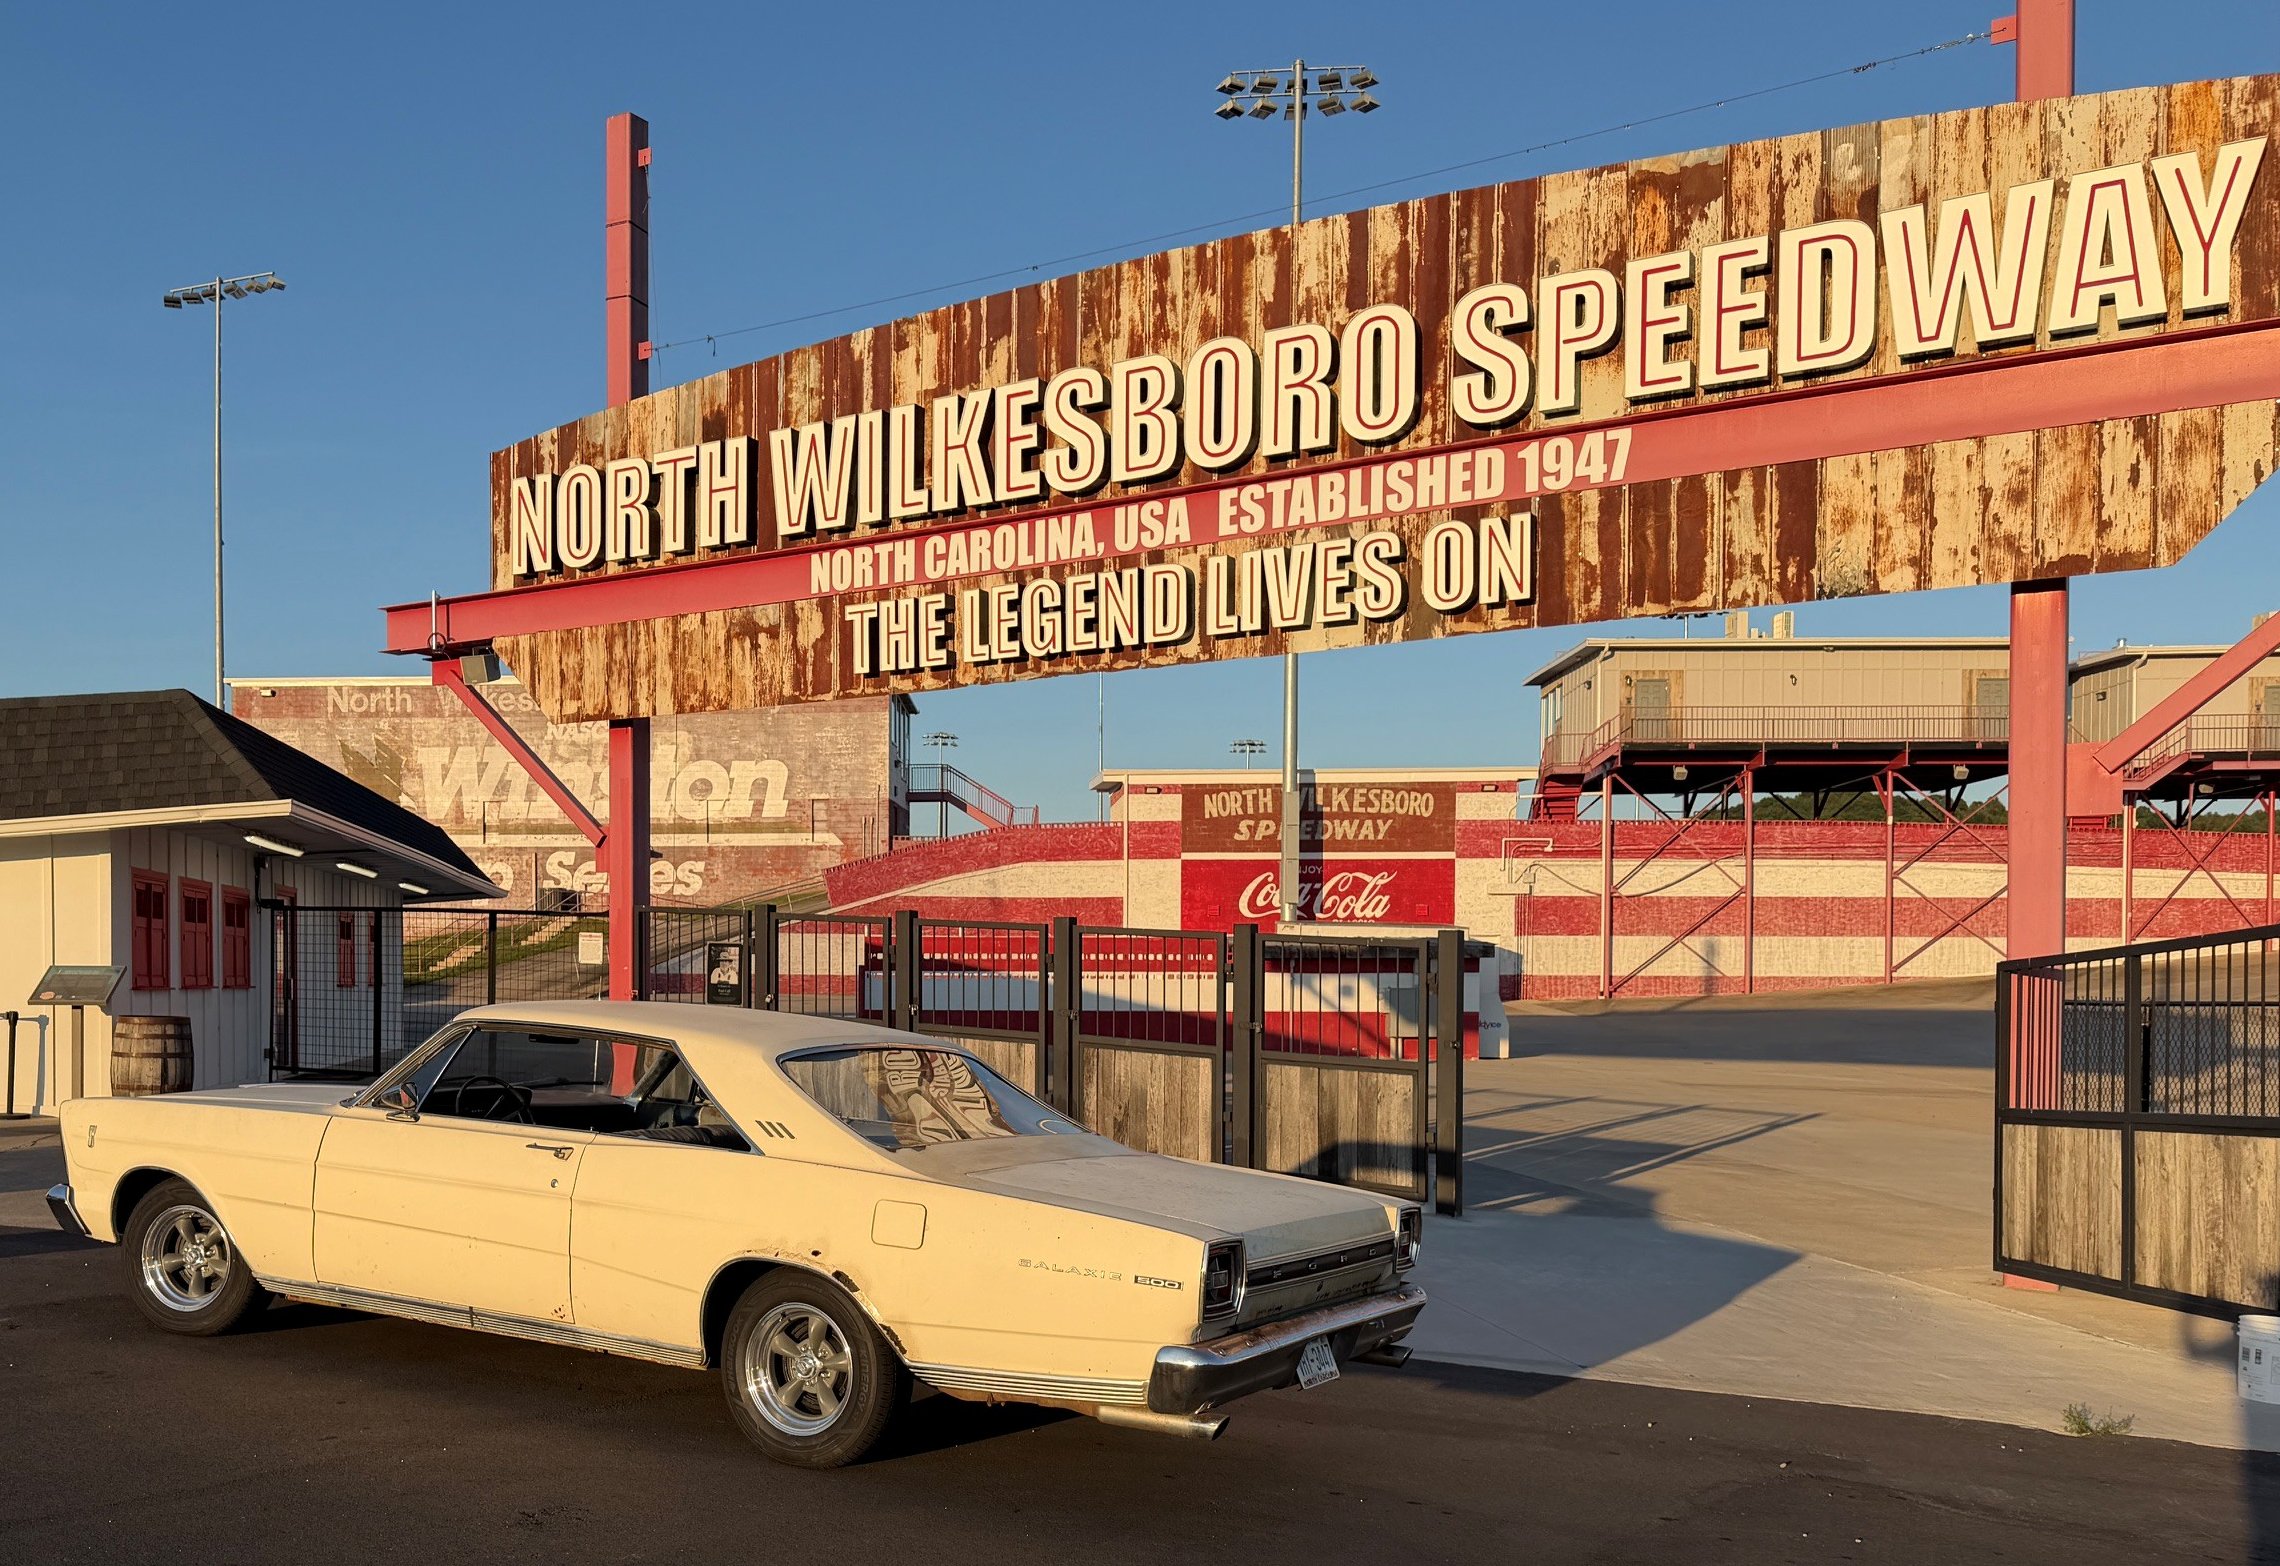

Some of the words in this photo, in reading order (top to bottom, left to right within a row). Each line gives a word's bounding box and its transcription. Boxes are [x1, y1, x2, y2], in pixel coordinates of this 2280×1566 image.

[512, 435, 750, 576] NORTH
[769, 302, 1417, 537] WILKESBORO
[1452, 136, 2267, 425] SPEEDWAY
[810, 540, 910, 594] NORTH
[924, 516, 1105, 580] CAROLINA,
[1114, 497, 1191, 553] USA
[1218, 449, 1505, 537] ESTABLISHED
[1518, 427, 1633, 493] 1947
[845, 594, 949, 675] THE
[963, 564, 1188, 666] LEGEND
[1206, 531, 1403, 636] LIVES
[1424, 511, 1532, 611] ON
[327, 686, 412, 713] North
[1204, 788, 1273, 819] NORTH
[1018, 1258, 1122, 1281] GALAXIE
[1136, 1275, 1180, 1290] 500
[1272, 1248, 1378, 1279] FORD
